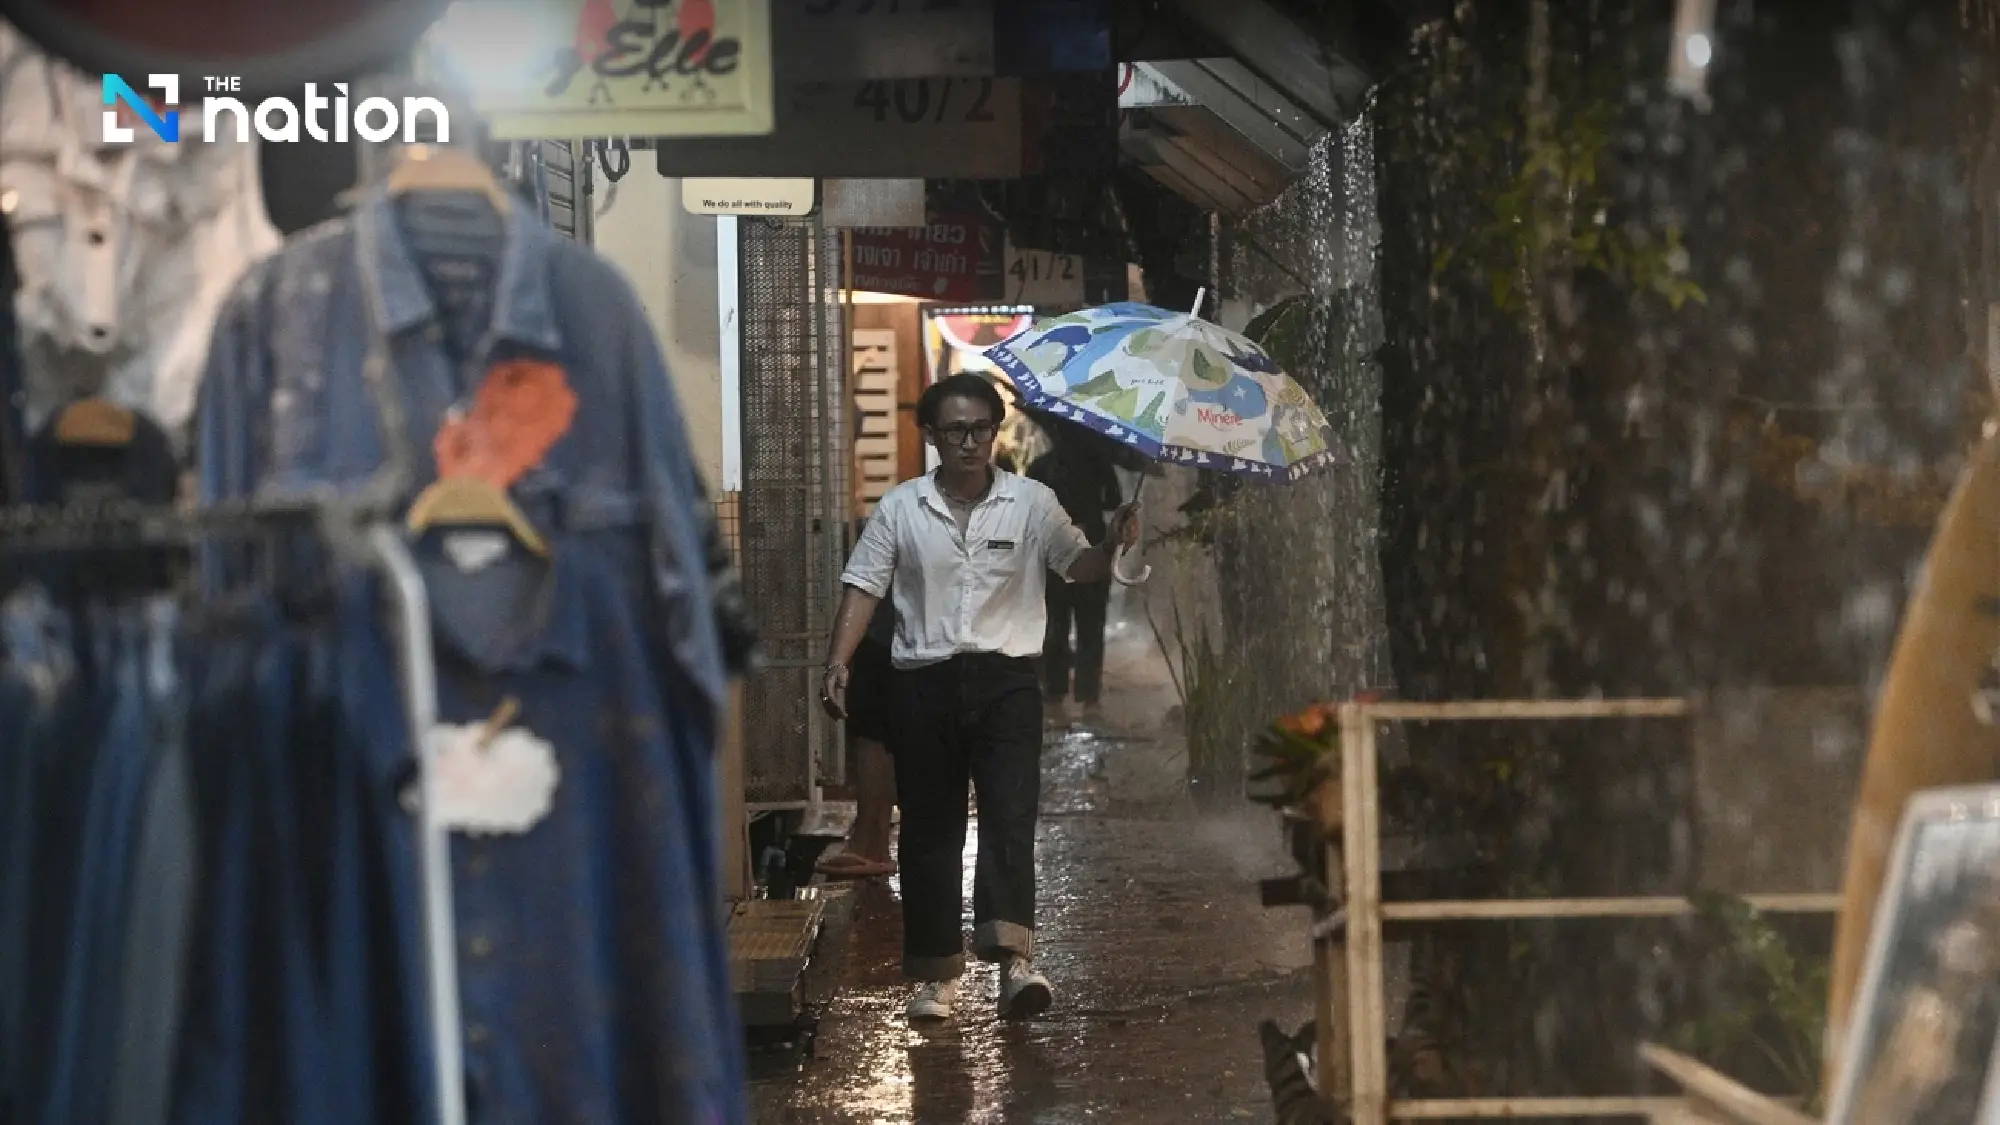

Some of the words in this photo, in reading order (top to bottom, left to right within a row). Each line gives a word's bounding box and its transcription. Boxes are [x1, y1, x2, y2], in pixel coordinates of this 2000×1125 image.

[593, 22, 740, 78] Elle
[853, 77, 995, 124] 40/2
[702, 199, 716, 209] We
[718, 199, 730, 209] do
[731, 199, 743, 209] all
[744, 199, 763, 209] with
[764, 199, 793, 210] quality
[1008, 255, 1076, 282] 41/2
